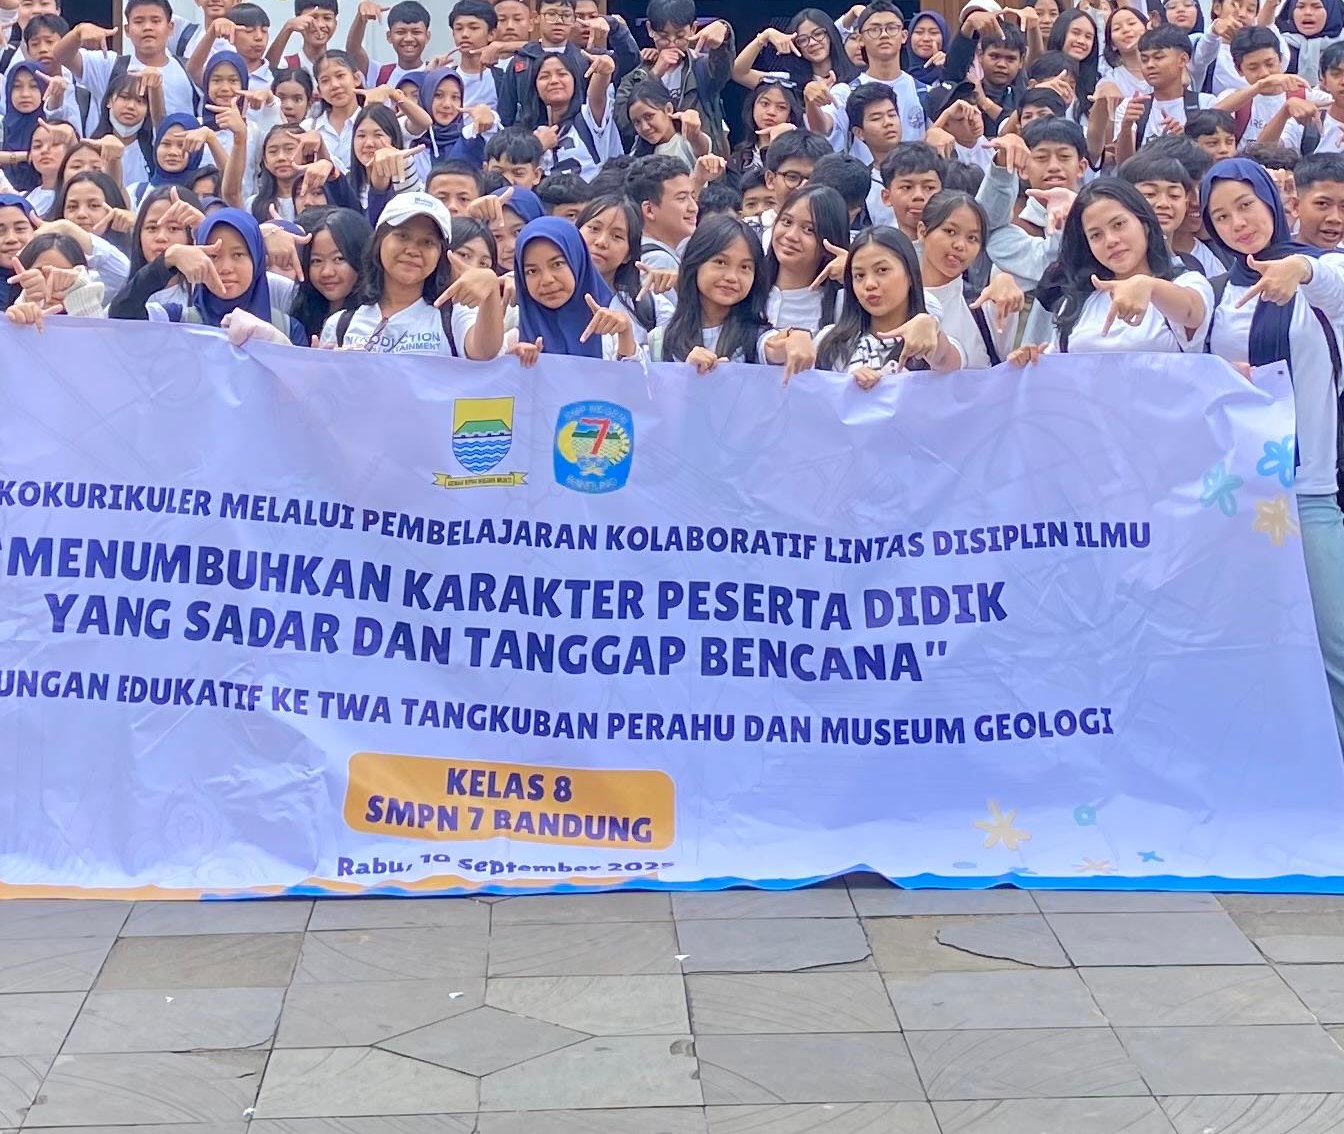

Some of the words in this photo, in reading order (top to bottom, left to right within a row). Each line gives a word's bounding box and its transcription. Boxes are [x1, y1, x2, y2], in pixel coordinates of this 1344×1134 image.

[581, 418, 611, 455] 7
[220, 492, 355, 530] MELALUI
[362, 508, 598, 550] PEMBELAJARAN
[606, 525, 817, 560] KOLABORATIF
[824, 532, 924, 564] LINTAS
[933, 521, 1069, 556] DISIPLIN
[1074, 521, 1151, 549] ILMU
[403, 569, 644, 620] KARAKTER
[657, 580, 852, 631] PESERTA
[864, 581, 1008, 628] DIDIK
[44, 593, 171, 640] YANG
[184, 600, 339, 654] SADAR
[352, 616, 451, 665] DAN
[464, 627, 686, 676] TANGGAP
[117, 675, 263, 711] EDUKATIF
[271, 686, 309, 715] KE
[318, 690, 392, 724] TWA
[401, 698, 598, 740] TANGKUBAN
[607, 712, 735, 741] PERAHU
[744, 715, 811, 743] DAN
[821, 717, 965, 746] MUSEUM
[974, 707, 1114, 742] GEOLOGI
[447, 767, 544, 802] KELAS
[553, 776, 572, 803] 8
[365, 795, 459, 832] SMPN
[468, 806, 485, 830] 7
[494, 809, 653, 843] BANDUNG
[337, 856, 413, 877] Rabu,
[457, 858, 601, 875] September
